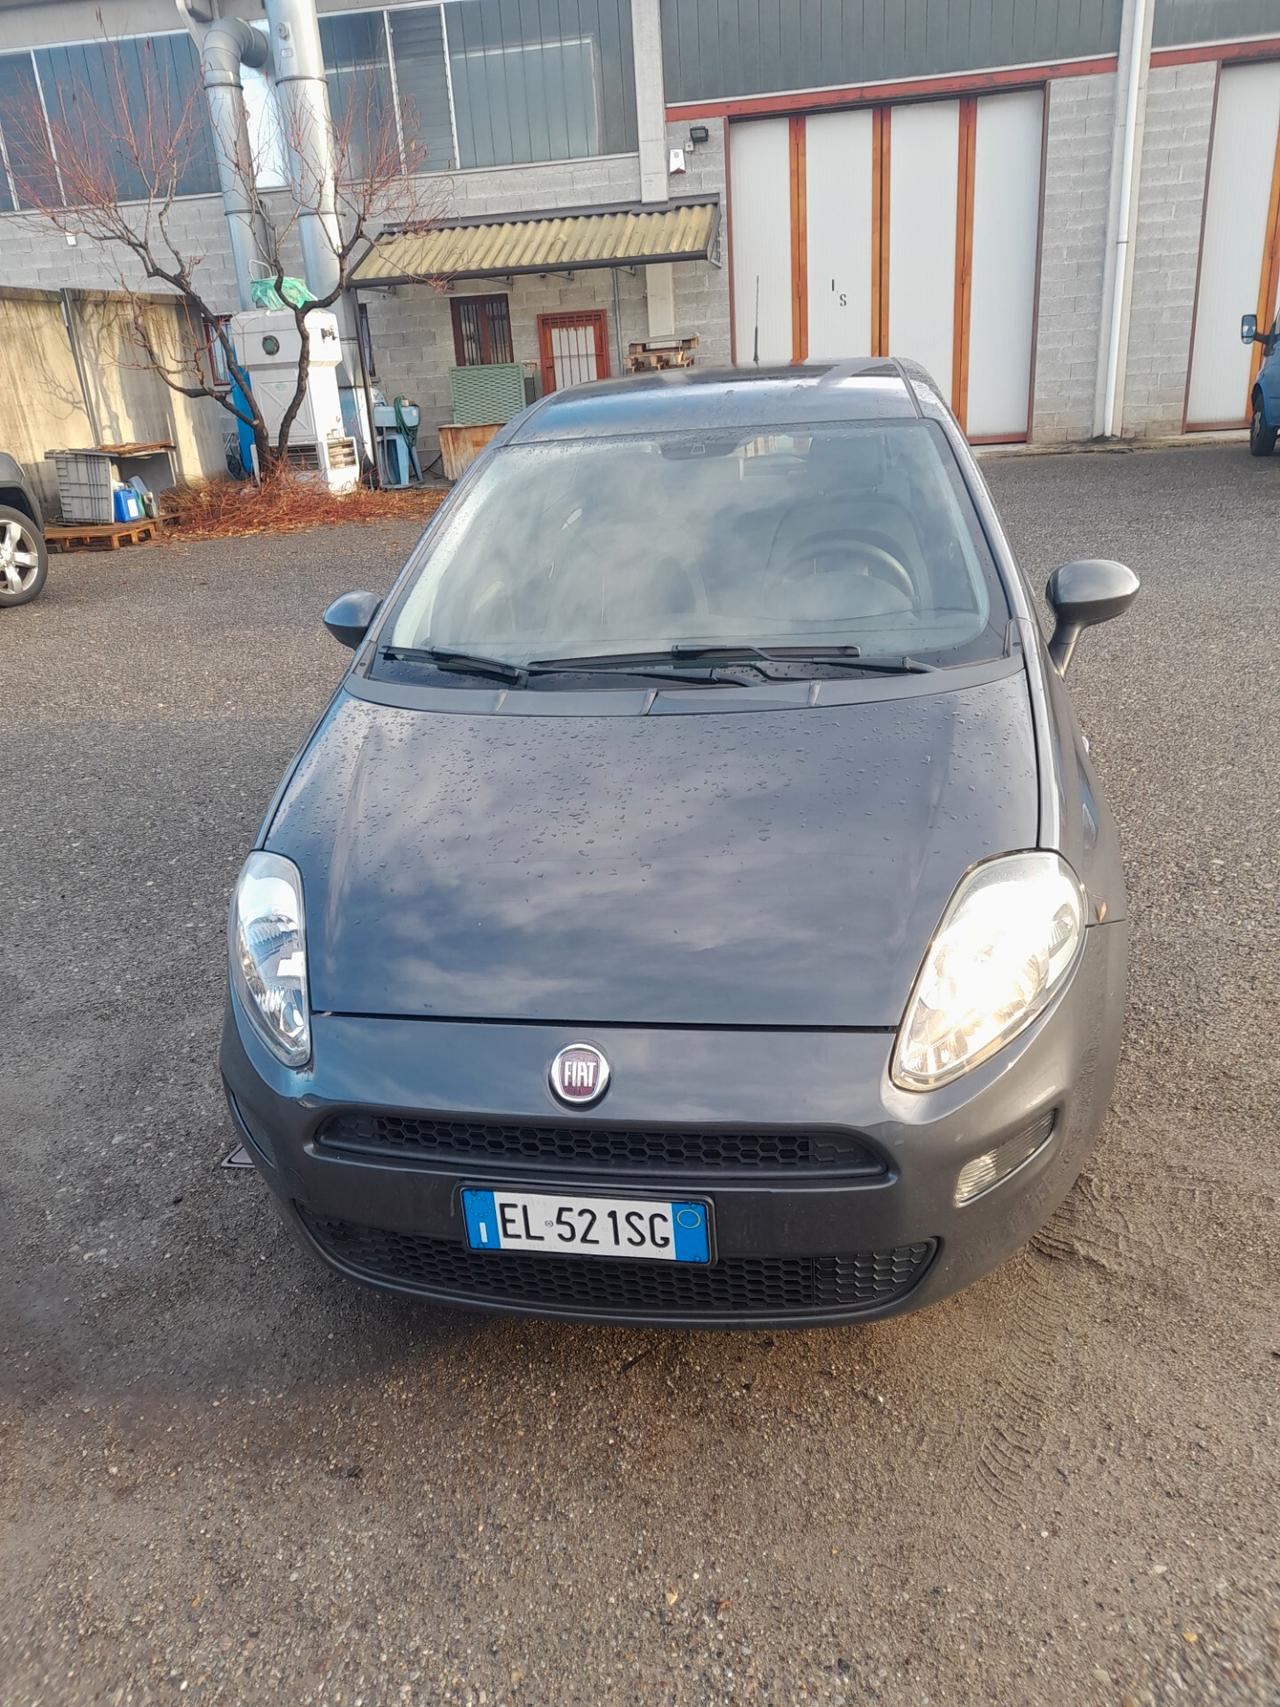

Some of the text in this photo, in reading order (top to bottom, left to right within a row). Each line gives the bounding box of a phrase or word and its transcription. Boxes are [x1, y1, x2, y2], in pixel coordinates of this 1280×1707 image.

[564, 1061, 597, 1087] FIAT
[479, 1222, 488, 1243] I
[499, 1203, 671, 1249] EL 521SG
